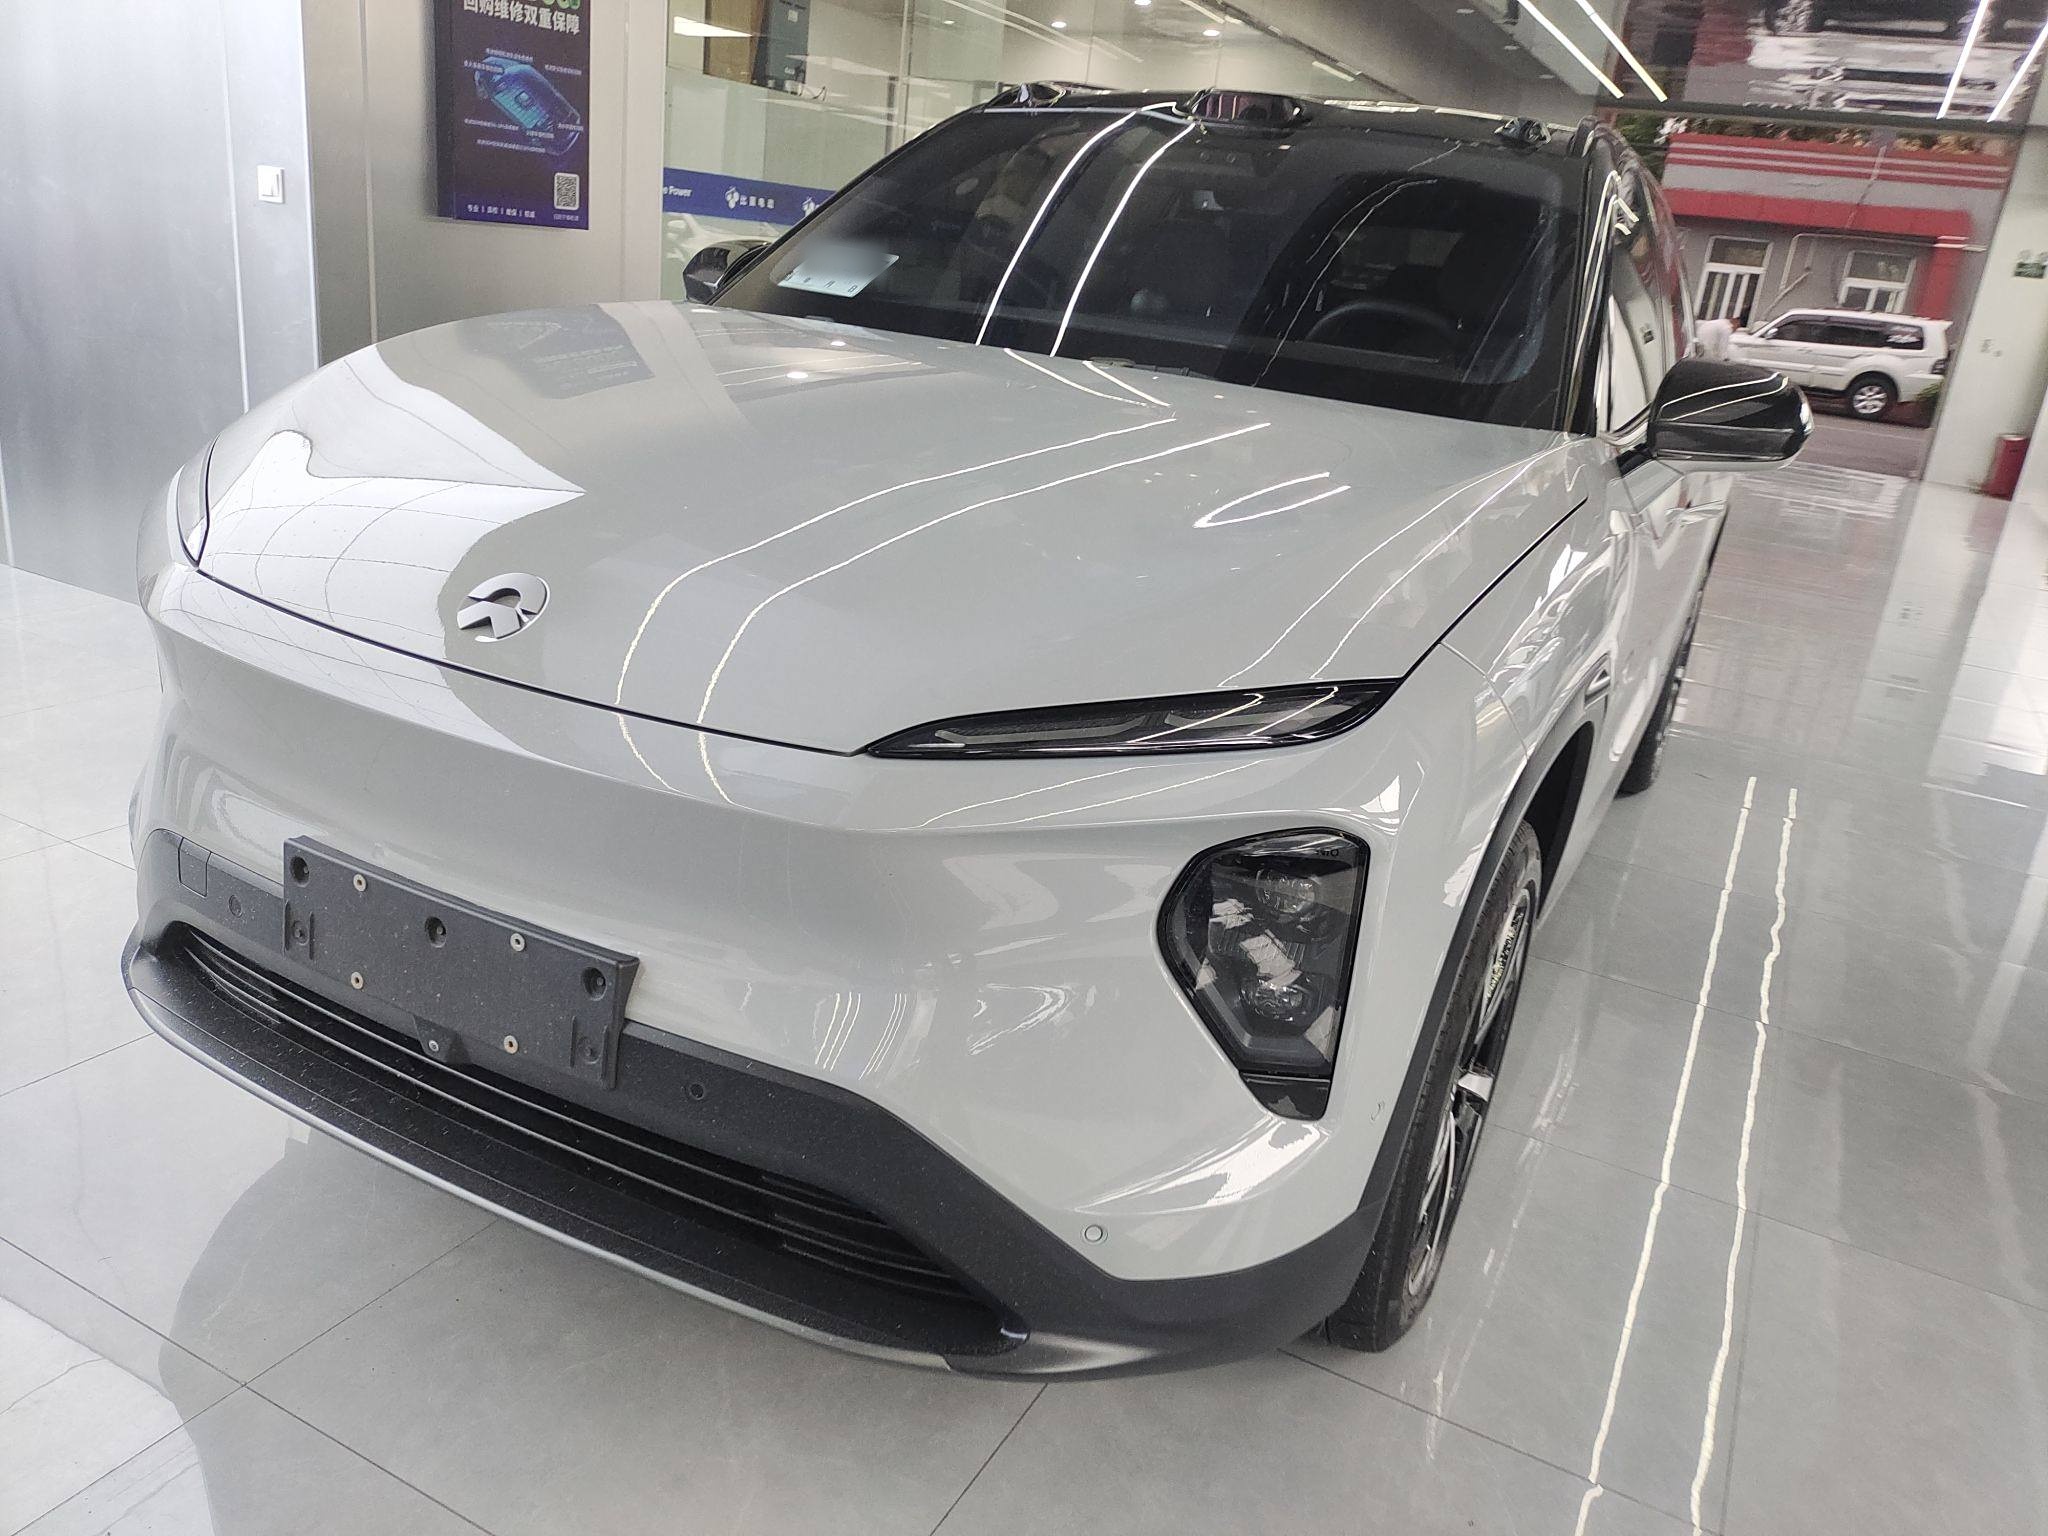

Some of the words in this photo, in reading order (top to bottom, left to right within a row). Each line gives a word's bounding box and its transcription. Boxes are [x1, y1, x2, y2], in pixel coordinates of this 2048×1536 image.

[463, 0, 580, 35] 回购维修双重保障
[669, 185, 693, 197] Power
